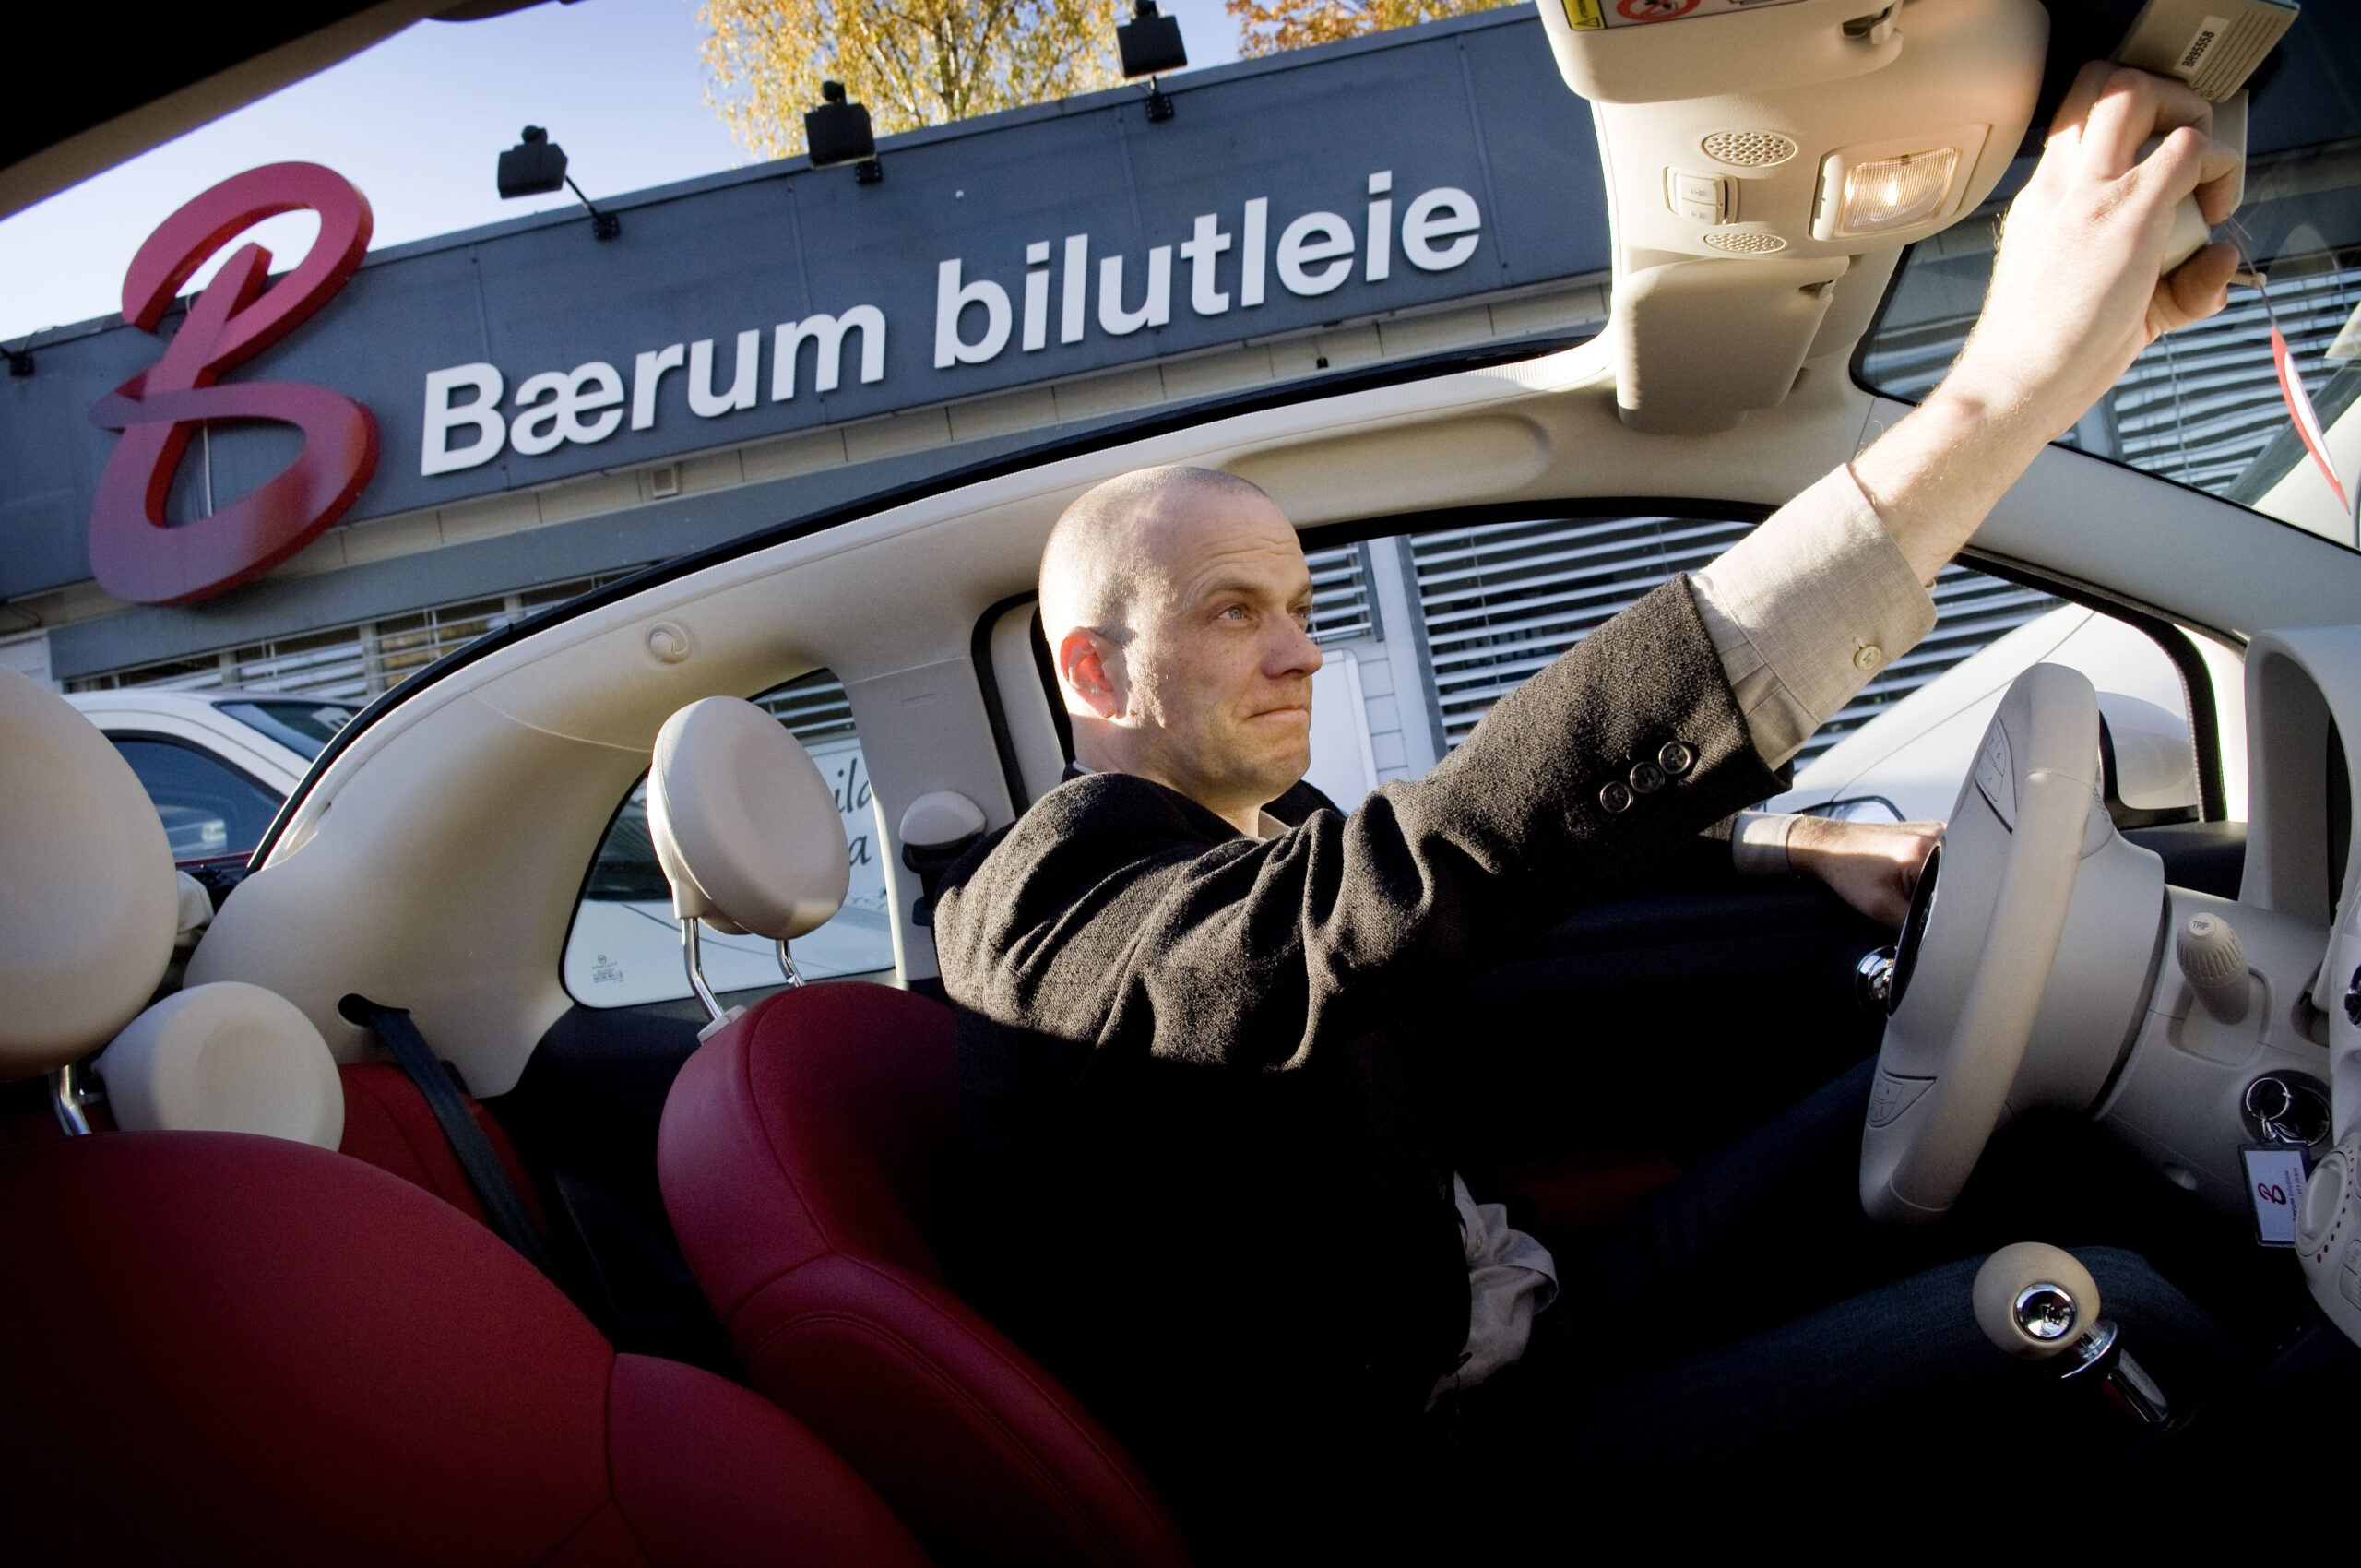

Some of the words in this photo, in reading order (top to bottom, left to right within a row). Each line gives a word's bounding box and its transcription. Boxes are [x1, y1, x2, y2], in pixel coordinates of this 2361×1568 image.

[88, 160, 380, 607] B
[421, 303, 886, 476] Bærum
[934, 170, 1481, 369] bilutleie
[2192, 921, 2210, 930] TRIP
